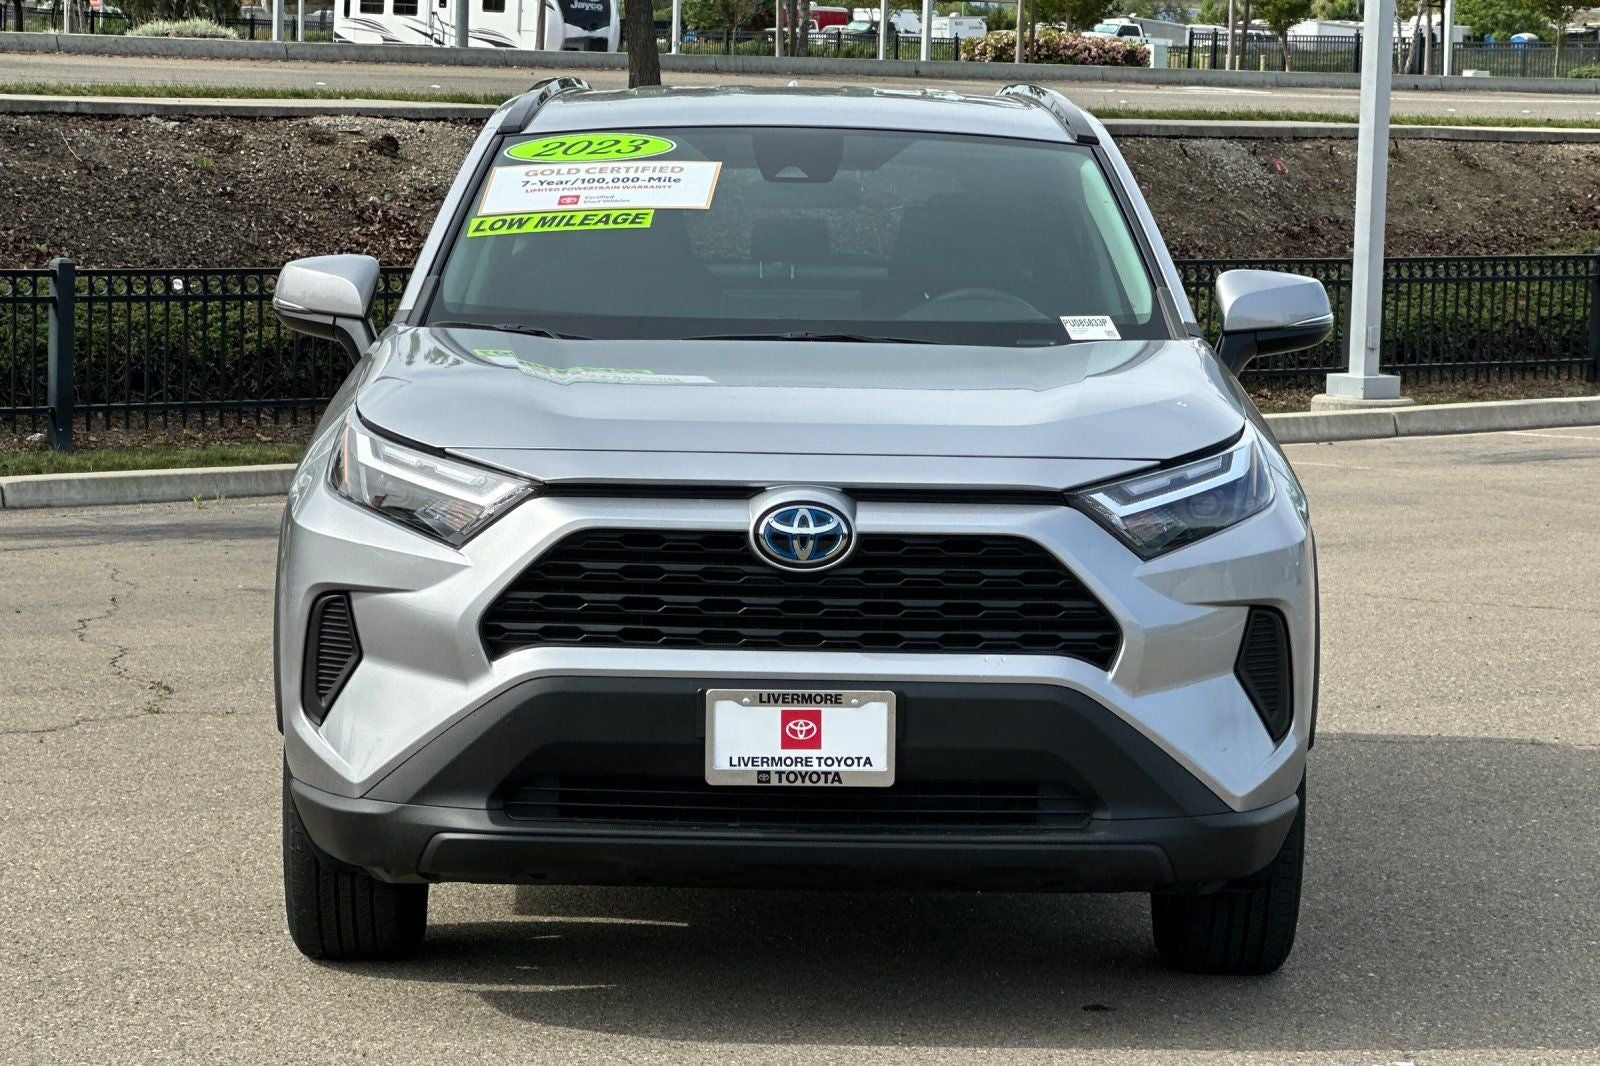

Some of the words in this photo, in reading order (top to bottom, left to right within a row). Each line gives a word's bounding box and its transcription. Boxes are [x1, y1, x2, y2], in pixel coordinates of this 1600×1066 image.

[569, 0, 603, 11] Jayco
[531, 139, 650, 157] 2023
[524, 168, 580, 177] GOLD
[585, 166, 685, 175] CERTIFIED
[521, 176, 682, 188] 7-Year/100,000-Mile
[472, 217, 532, 233] LOW
[533, 213, 650, 229] MILEAGE
[758, 692, 843, 705] LIVERMORE
[729, 756, 814, 768] LIVERMORE
[816, 756, 873, 768] TOYOTA
[775, 771, 843, 784] TOYOTA
